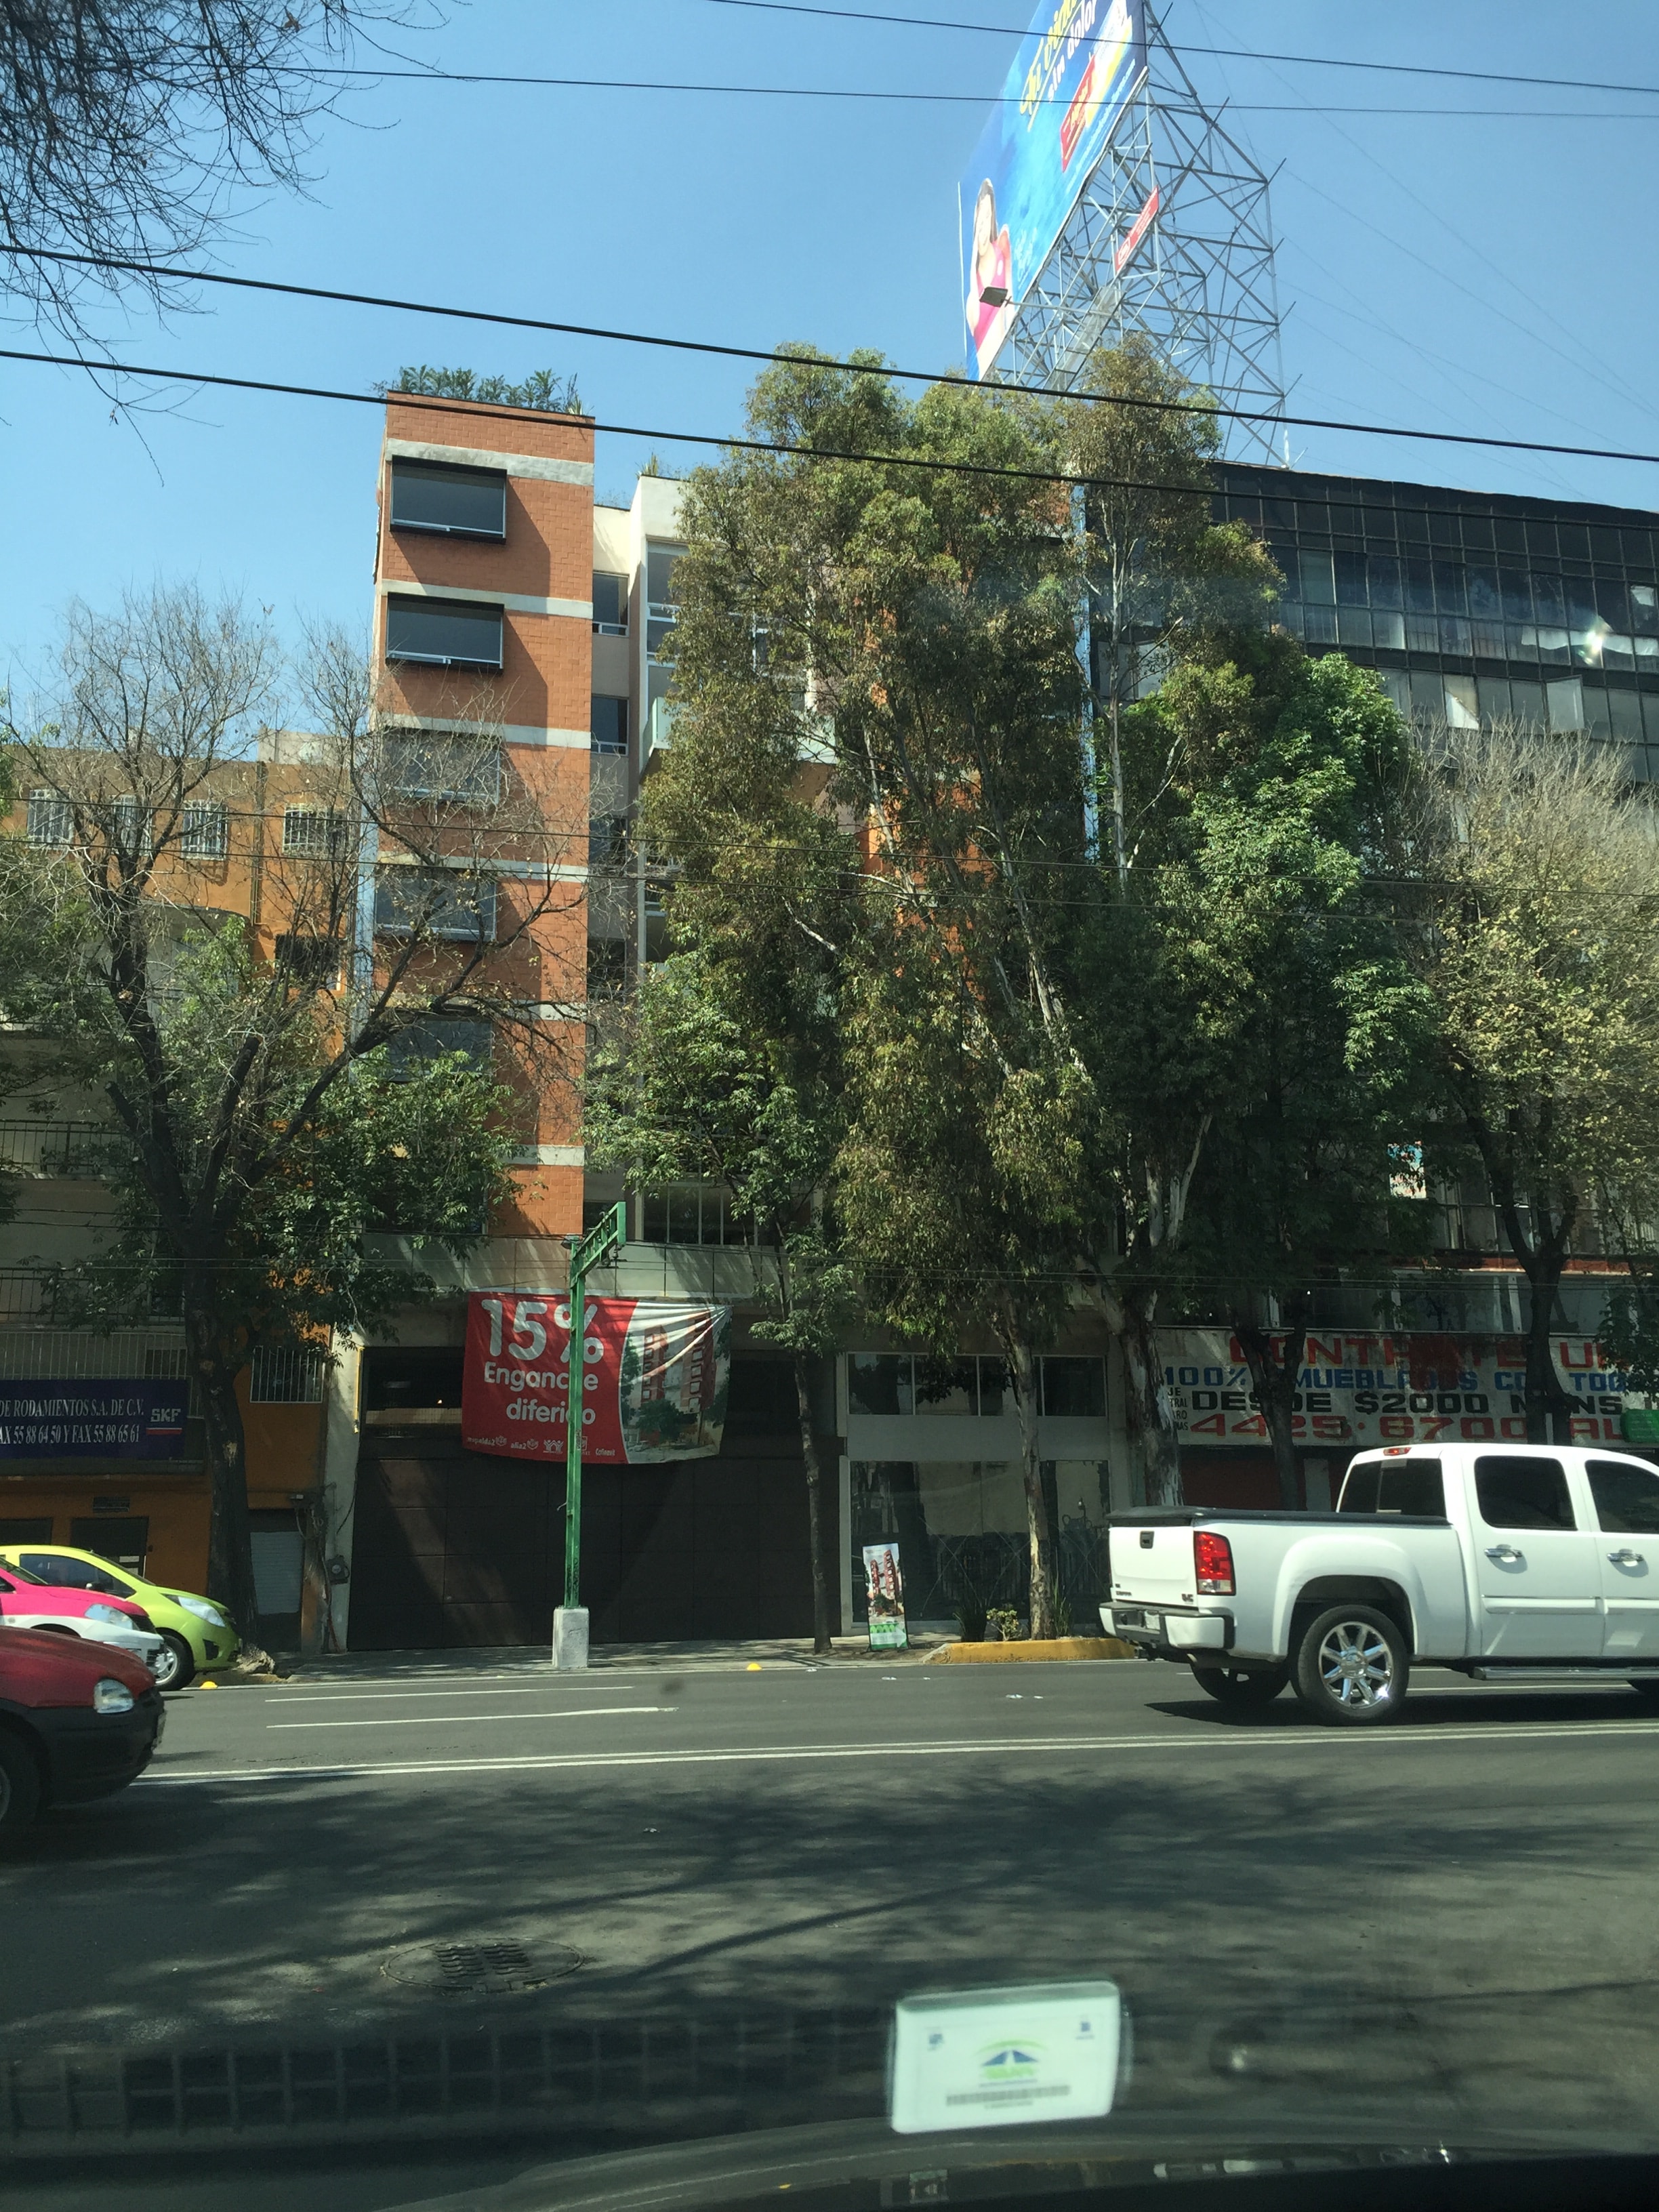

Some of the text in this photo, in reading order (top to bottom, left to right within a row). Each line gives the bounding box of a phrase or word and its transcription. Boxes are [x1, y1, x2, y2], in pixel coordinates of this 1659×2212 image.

[481, 1298, 604, 1364] 15%
[484, 1361, 598, 1391] Engance
[1164, 1366, 1248, 1387] 100%
[1277, 1368, 1478, 1390] MUEBLS
[14, 1399, 89, 1418] RODAMIENTOS
[91, 1399, 108, 1416] S.A.
[110, 1399, 124, 1416] DE
[127, 1398, 144, 1416] C.V.
[1355, 1391, 1489, 1414] $2000
[150, 1408, 182, 1423] SKF
[13, 1426, 24, 1444] 55
[26, 1425, 36, 1444] 88
[38, 1425, 49, 1443] 64
[51, 1425, 61, 1443] 50
[64, 1425, 70, 1443] Y
[72, 1425, 91, 1443] FAX
[94, 1424, 104, 1443] 55
[106, 1424, 116, 1442] 88
[118, 1424, 129, 1442] 65
[130, 1423, 140, 1442] 61
